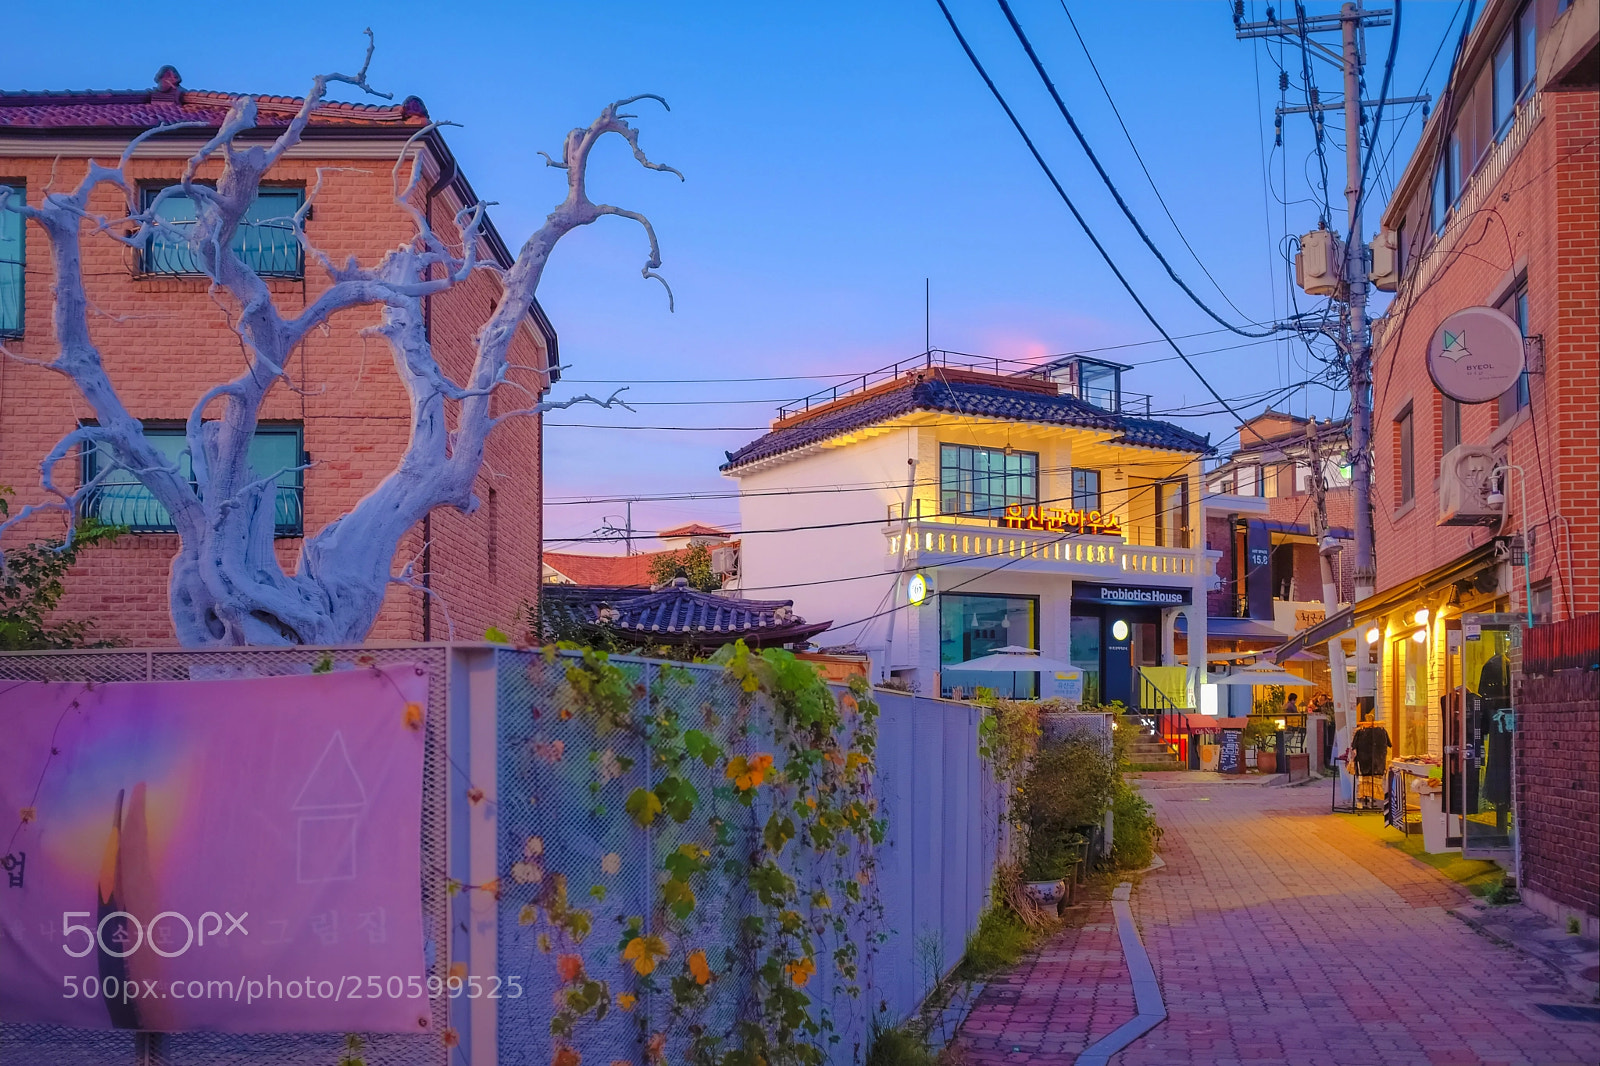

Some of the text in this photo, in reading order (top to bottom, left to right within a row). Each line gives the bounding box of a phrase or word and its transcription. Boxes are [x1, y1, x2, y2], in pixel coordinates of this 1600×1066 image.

[1003, 502, 1122, 535] 유산균하우스
[1101, 587, 1182, 603] Probiotics House
